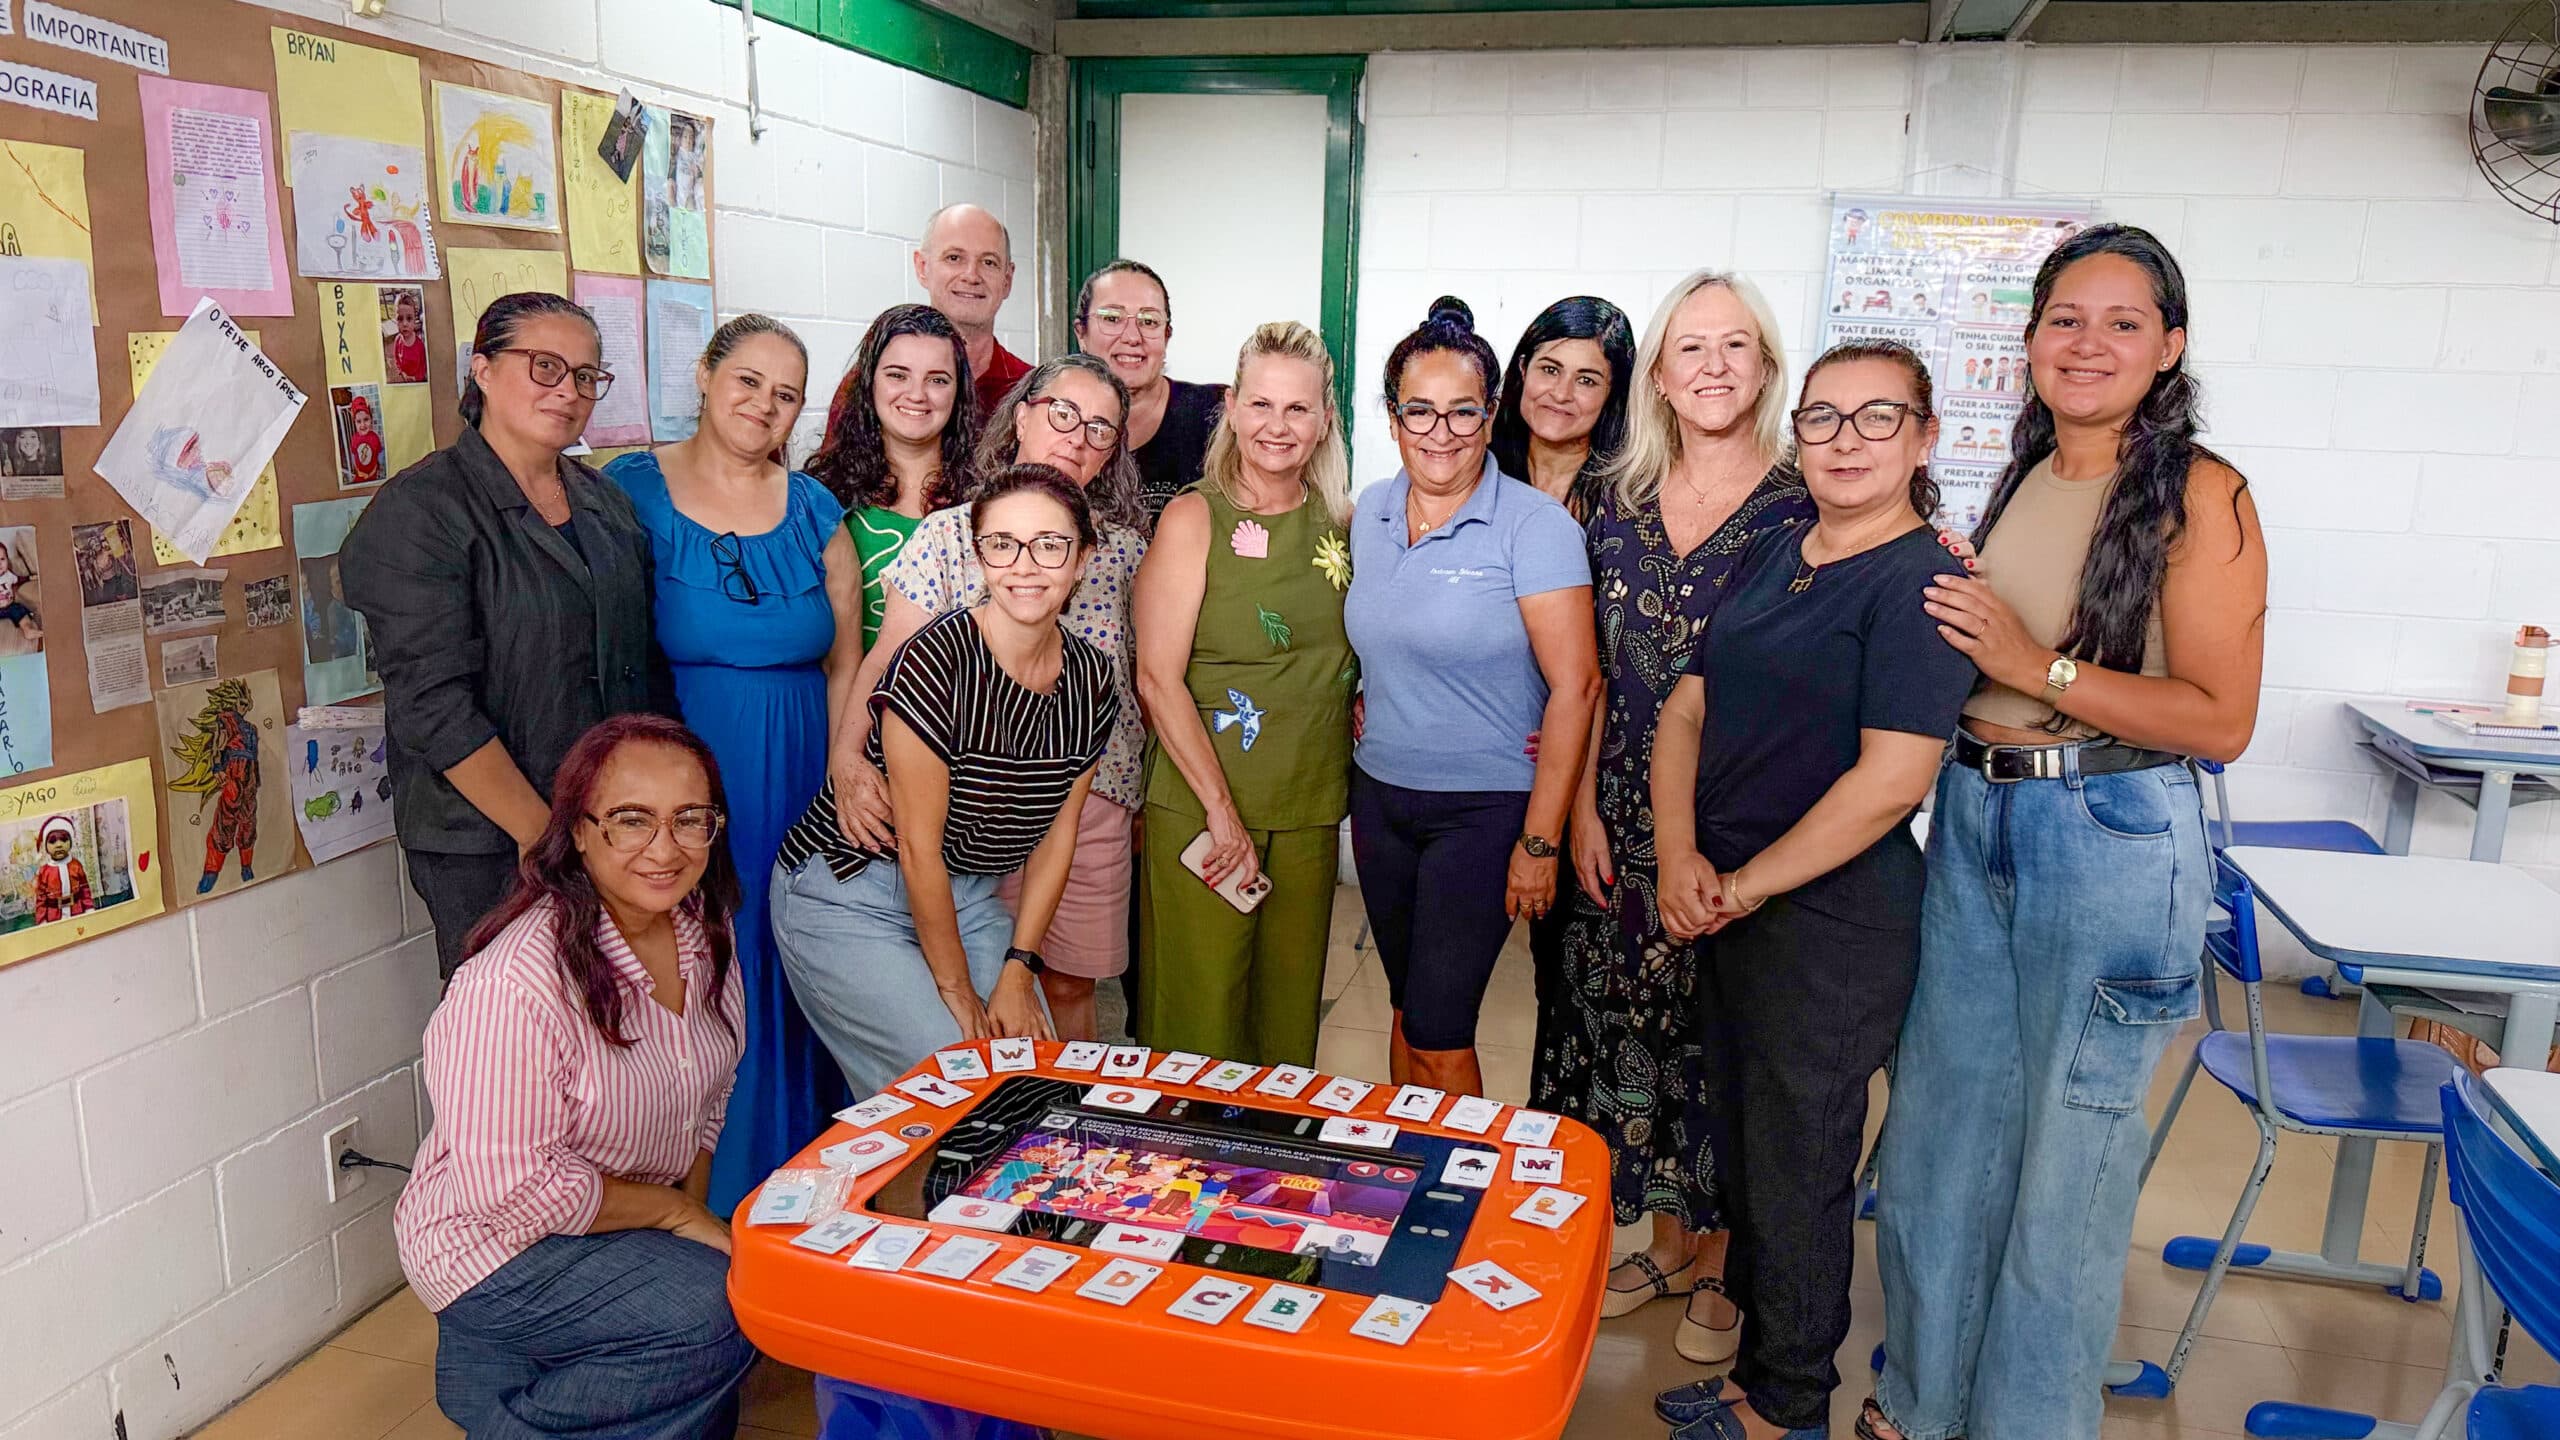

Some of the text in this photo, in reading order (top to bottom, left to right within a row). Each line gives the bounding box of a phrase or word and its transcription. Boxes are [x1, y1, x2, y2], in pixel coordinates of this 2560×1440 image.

[30, 11, 166, 68] IMPORTANTE!
[286, 32, 336, 64] BRYAN
[1967, 273, 1998, 284] COM
[334, 284, 352, 375] BRYAN
[1832, 325, 1917, 337] TRATE BEM OS
[1955, 331, 1988, 341] TENHA
[209, 308, 220, 321] O
[219, 320, 249, 352] PEIXE
[250, 353, 275, 379] ARCO
[1965, 342, 1974, 350] O
[1975, 343, 1994, 351] SEU
[1948, 400, 1978, 409] FAZER
[1979, 402, 1991, 410] AS
[1943, 409, 1977, 419] ESCOLA
[1979, 412, 2001, 420] COM
[1944, 468, 1984, 478] PRESTAR
[1936, 479, 1980, 489] DURANTE
[14, 787, 57, 816] YAGO
[1113, 1053, 1140, 1068] U
[1167, 1060, 1198, 1072] T
[1218, 1068, 1243, 1080] S
[1276, 1072, 1297, 1085] R
[1280, 1176, 1322, 1191] CIRCO
[1103, 1270, 1138, 1288] D
[1192, 1290, 1233, 1307] C
[1270, 1297, 1299, 1316] B
